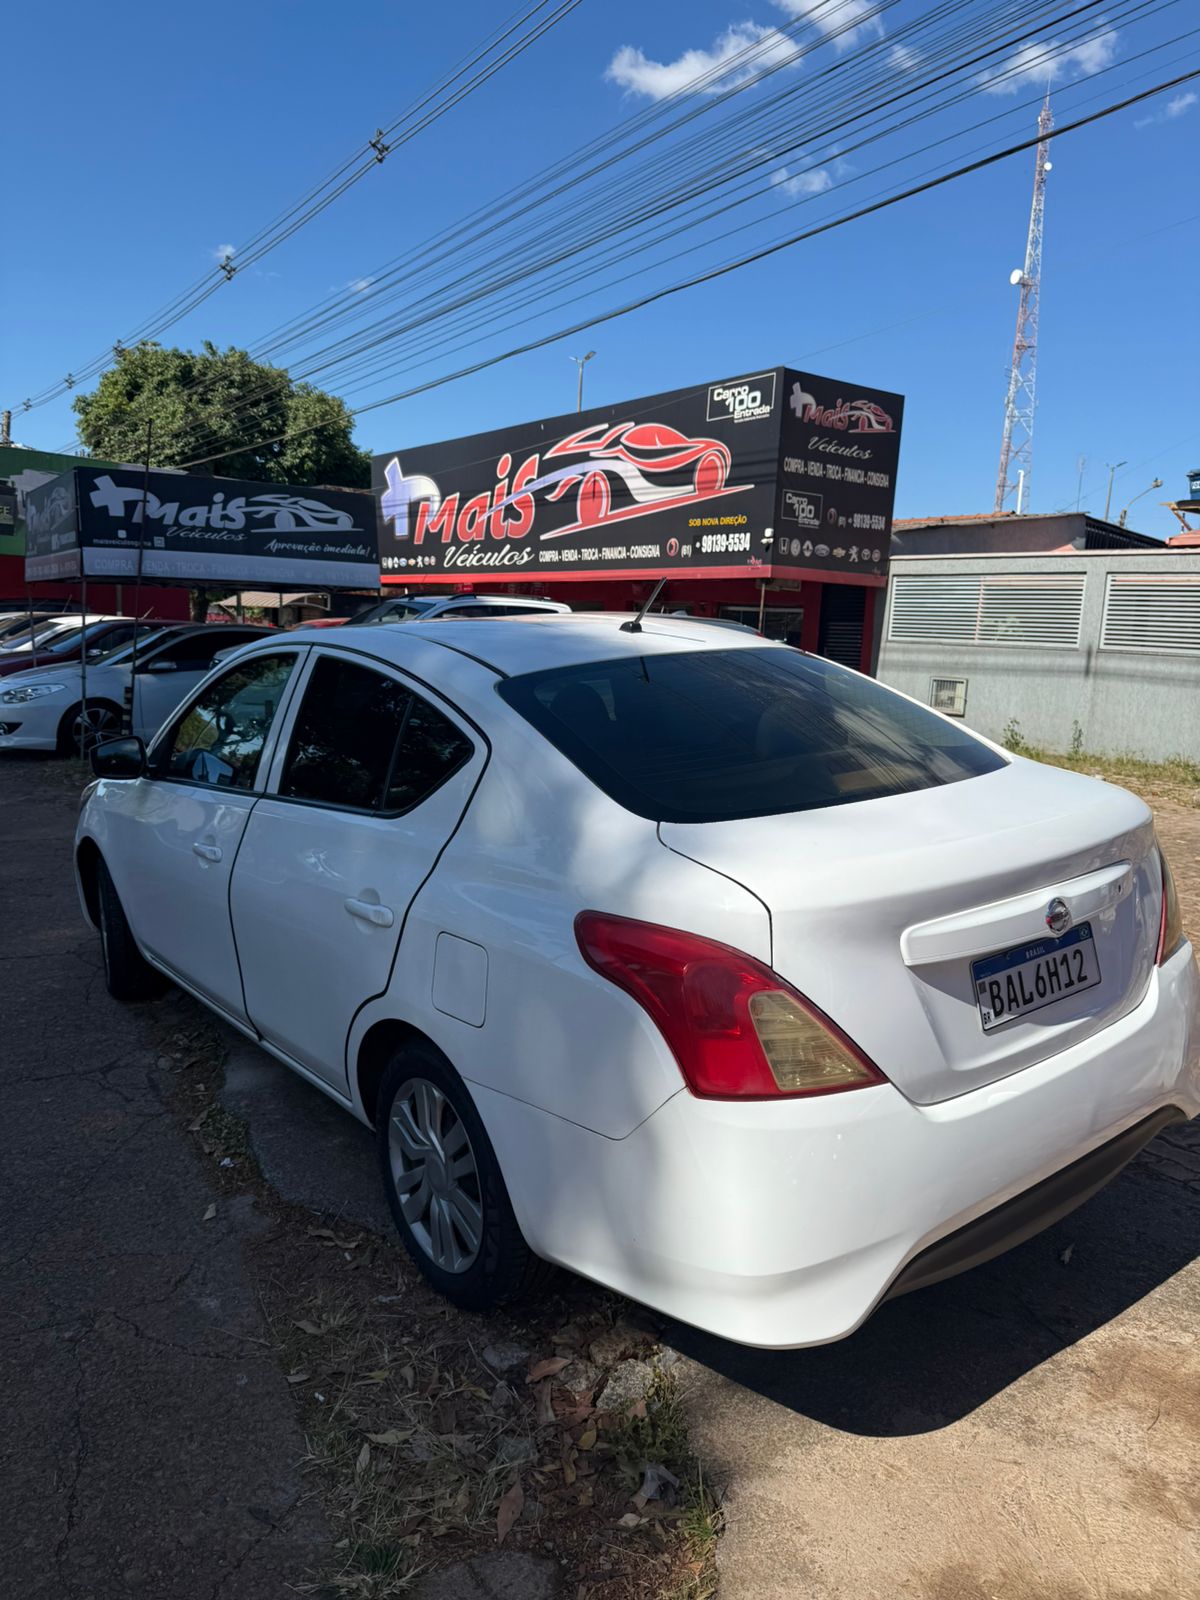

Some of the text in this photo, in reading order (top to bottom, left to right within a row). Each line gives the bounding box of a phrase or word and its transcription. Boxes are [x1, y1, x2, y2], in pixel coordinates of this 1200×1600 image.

[714, 385, 749, 401] Carro
[725, 391, 761, 412] 100
[734, 404, 770, 419] Entrada
[803, 398, 850, 430] Mais
[783, 457, 805, 474] COMPRA
[807, 461, 823, 477] VENDA
[826, 464, 842, 480] TROCA
[844, 467, 865, 484] FINANCIA
[414, 453, 539, 545] Mais
[132, 492, 246, 530] Mais
[688, 514, 747, 527] SOB NOVA DIREÇÃO
[793, 504, 815, 518] 100
[701, 532, 751, 553] 98139-5534
[443, 544, 535, 568] Veículos
[539, 544, 661, 563] COMPRA VENDA TROCA FINANCIA CONSIGNA
[988, 948, 1088, 1019] BAL6H12
